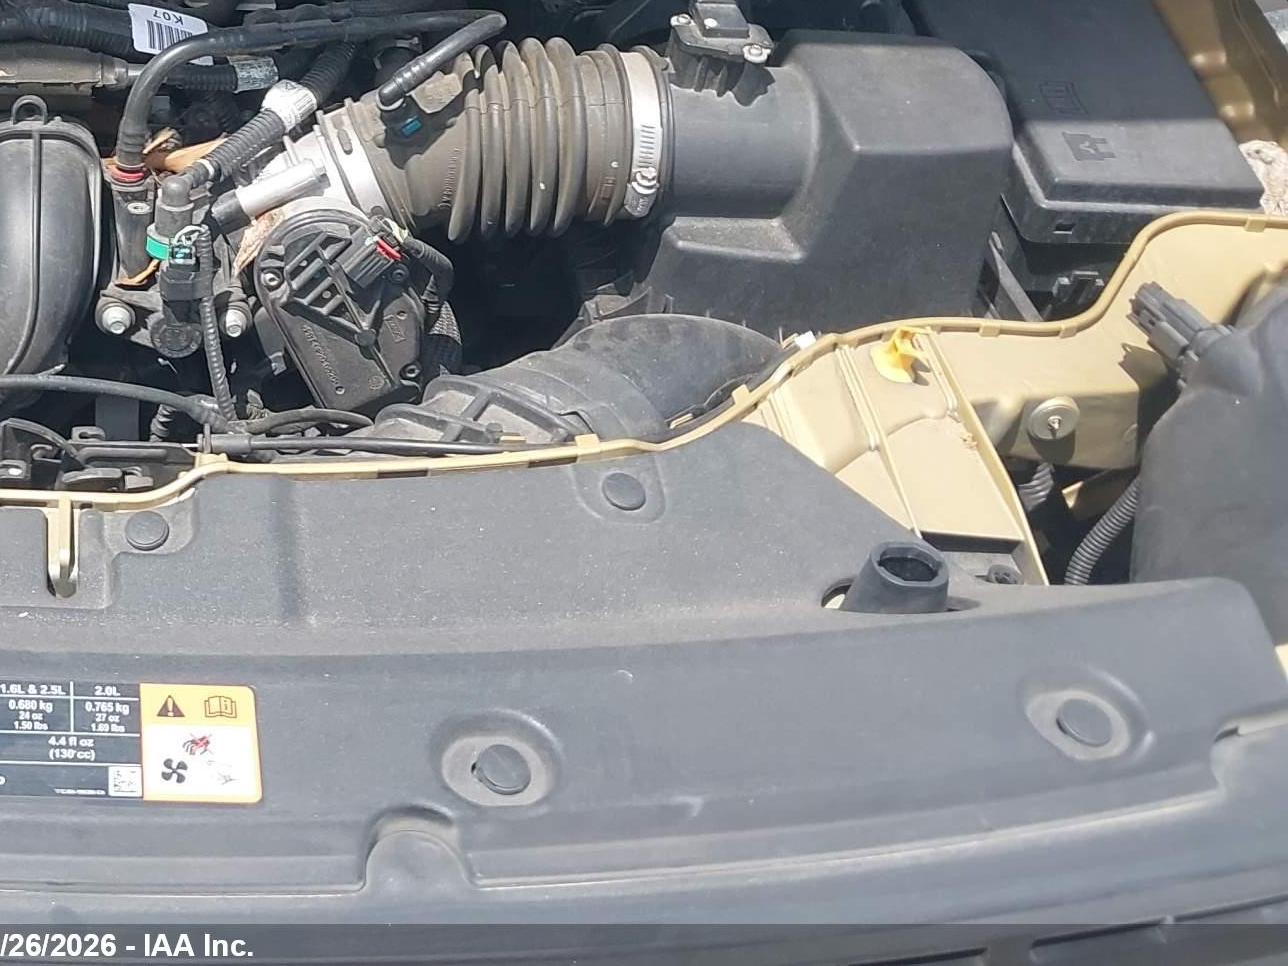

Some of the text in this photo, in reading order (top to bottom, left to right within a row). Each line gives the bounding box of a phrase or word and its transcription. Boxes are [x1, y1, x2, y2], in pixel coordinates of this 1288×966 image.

[152, 9, 185, 26] K07
[0, 683, 67, 696] 1.6L & 2.5L
[94, 685, 121, 697] 2.0L
[8, 699, 54, 713] 0.680 kg
[84, 701, 130, 715] 0.765 kg
[18, 710, 44, 721] 24 oz
[95, 713, 121, 723] 27 oz
[13, 720, 49, 731] 1.50 lbs
[110, 723, 126, 733] lbs
[48, 735, 95, 748] 4.4 fl oz
[76, 750, 97, 762] cc)
